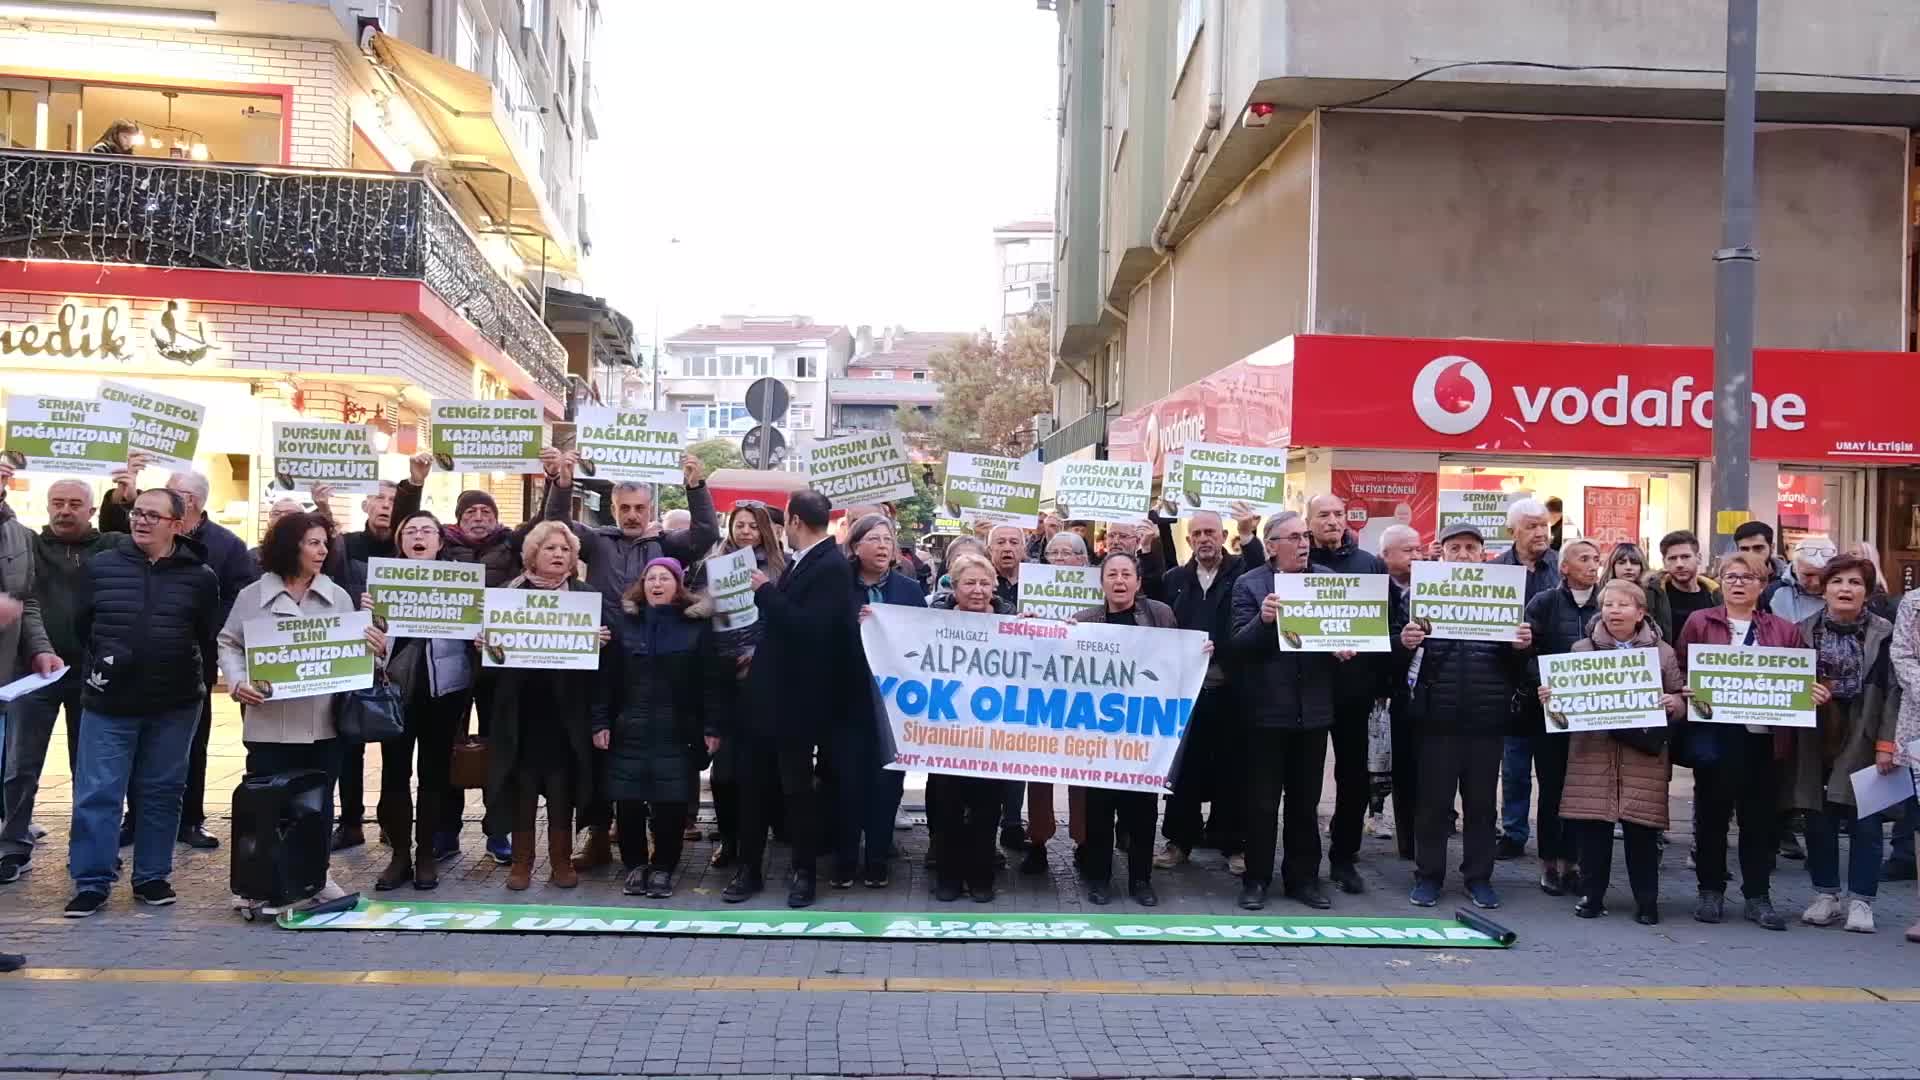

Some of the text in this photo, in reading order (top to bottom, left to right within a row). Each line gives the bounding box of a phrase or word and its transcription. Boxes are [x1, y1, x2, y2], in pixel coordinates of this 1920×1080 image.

[38, 399, 101, 413] SERMAYE
[102, 388, 198, 422] CENGİZ DEFOL
[438, 405, 537, 419] CENGİZ DEFOL
[616, 412, 647, 427] KAZ
[11, 423, 122, 444] DOĞAMIZDAN
[128, 417, 191, 442] DAĞLARI
[282, 426, 367, 441] DURSUN ALİ
[442, 426, 533, 443] KAZDAĞLARI
[583, 424, 679, 445] DAĞLARI'NA
[1159, 410, 1206, 452] vodafone
[51, 441, 86, 457] ÇEK!
[278, 440, 371, 455] KOYUNCU'YA
[453, 439, 523, 456] BİZİMDİR!
[811, 434, 891, 460] DURSUN ALİ
[1836, 441, 1913, 453] UMAY İLETİŞİM
[582, 446, 680, 468] DOKUNMA!
[809, 448, 899, 476] KOYUNCU'YA
[972, 456, 1020, 471] SERMAYE
[1190, 449, 1280, 467] CENGİZ DEFOL
[278, 459, 376, 479] ÖZGÜRLÜK!
[1066, 463, 1142, 478] DURSUN ALİ
[1191, 469, 1277, 487] KAZDAĞLARI
[813, 465, 909, 497] ÖZGÜRLÜK!
[950, 476, 1035, 499] DOĞAMIZDAN
[1060, 475, 1144, 490] KOYUNCU'YA
[1200, 481, 1265, 499] BİZİMDİR!
[1350, 483, 1365, 493] TEK
[1366, 483, 1386, 494] FİYAT
[976, 494, 1007, 511] ÇEK!
[1056, 489, 1145, 511] ÖZGÜRLÜK!
[1463, 493, 1508, 502] SERMAYE
[1444, 514, 1506, 526] DOĞAMIZD
[374, 565, 480, 583] CENGİZ DEFOL
[1055, 569, 1085, 583] KAZ
[1304, 577, 1360, 588] SERMAYE
[1451, 567, 1484, 582] KAZ
[376, 588, 474, 607] KAZDAĞLARI
[1023, 580, 1104, 600] DAĞLARI'N
[1316, 587, 1346, 600] ELİNİ
[1416, 580, 1517, 599] DAĞLARI'NA
[526, 595, 559, 609] KAZ
[1023, 602, 1080, 619] DOKU
[1283, 602, 1381, 618] DOĞAMIZDAN
[388, 603, 463, 620] BİZİMDİR!
[489, 606, 592, 627] DAĞLARI'NA
[1415, 603, 1519, 623] DOKUNMA!
[277, 617, 340, 632] SERMAYE
[998, 620, 1068, 640] ESKİŞEHİR
[1319, 618, 1350, 635] ÇEK!
[293, 629, 327, 643] ELİNİ
[489, 631, 595, 651] DOKUNMA!
[254, 643, 366, 665] DOĞAMIZDAN
[1077, 640, 1121, 655] TEPEBAŞI
[920, 643, 1136, 687] ALPAGUT-ATALAN
[1550, 653, 1646, 674] DURSUN ALİ
[1696, 650, 1809, 668] CENGİZ DEFOL
[296, 661, 331, 680] ÇEK!
[1547, 670, 1653, 690] KOYUNCU'YA
[1699, 673, 1805, 693] KAZDAĞLARI
[874, 674, 1193, 738] YOK OLMASIN!
[1547, 689, 1660, 713] ÖZGÜRLÜK!
[1711, 688, 1792, 708] BİZİMDİR!
[903, 719, 1151, 765] Siyanürlü Madene Geçit Yok!
[1061, 768, 1100, 782] HAYIR
[510, 916, 863, 935] UNUTMA
[884, 920, 1091, 931] ALPAGUT
